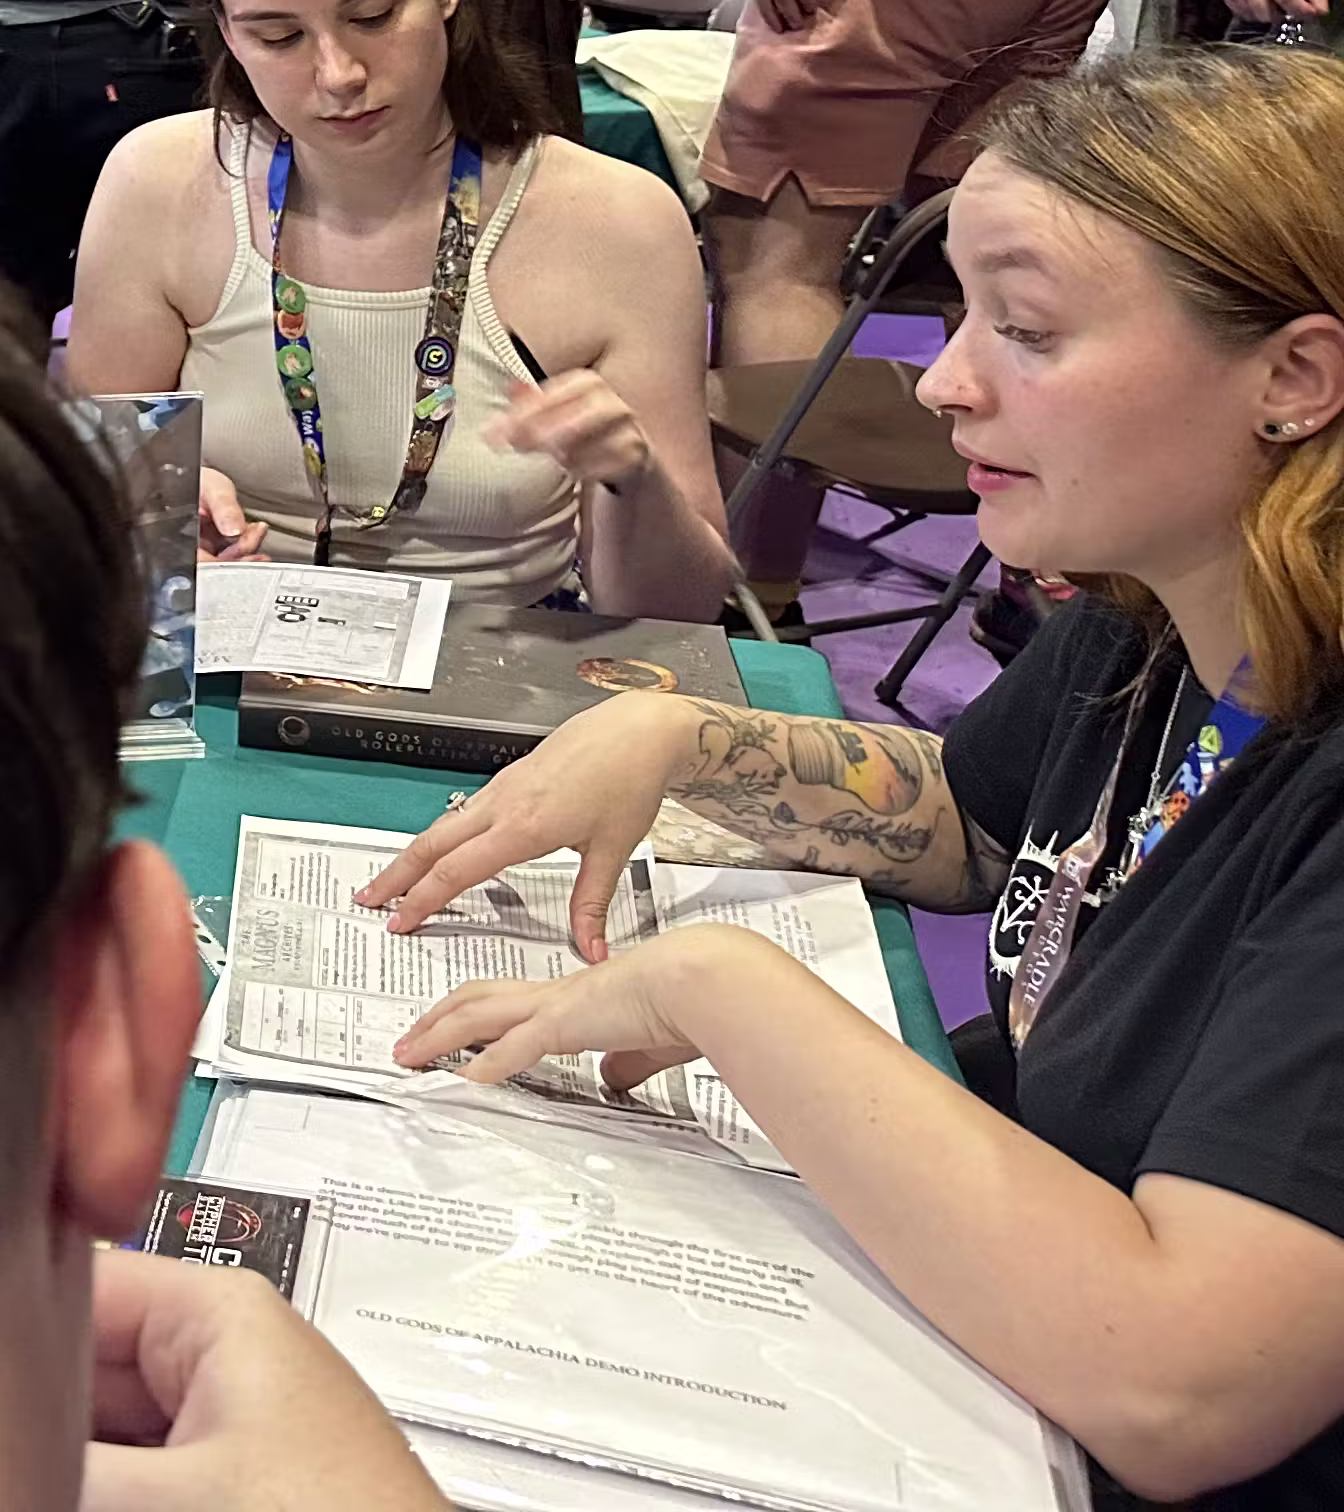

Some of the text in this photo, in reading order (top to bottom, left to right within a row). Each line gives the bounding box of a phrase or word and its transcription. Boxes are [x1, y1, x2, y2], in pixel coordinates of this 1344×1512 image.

[330, 725, 365, 740] OLD
[374, 729, 421, 746] GODS
[251, 908, 281, 973] MAGNUS
[1024, 886, 1075, 1009] WARCRADLE
[355, 1307, 789, 1412] OLD GODS OF APPALACHIA DEMO INTRODUCTION
